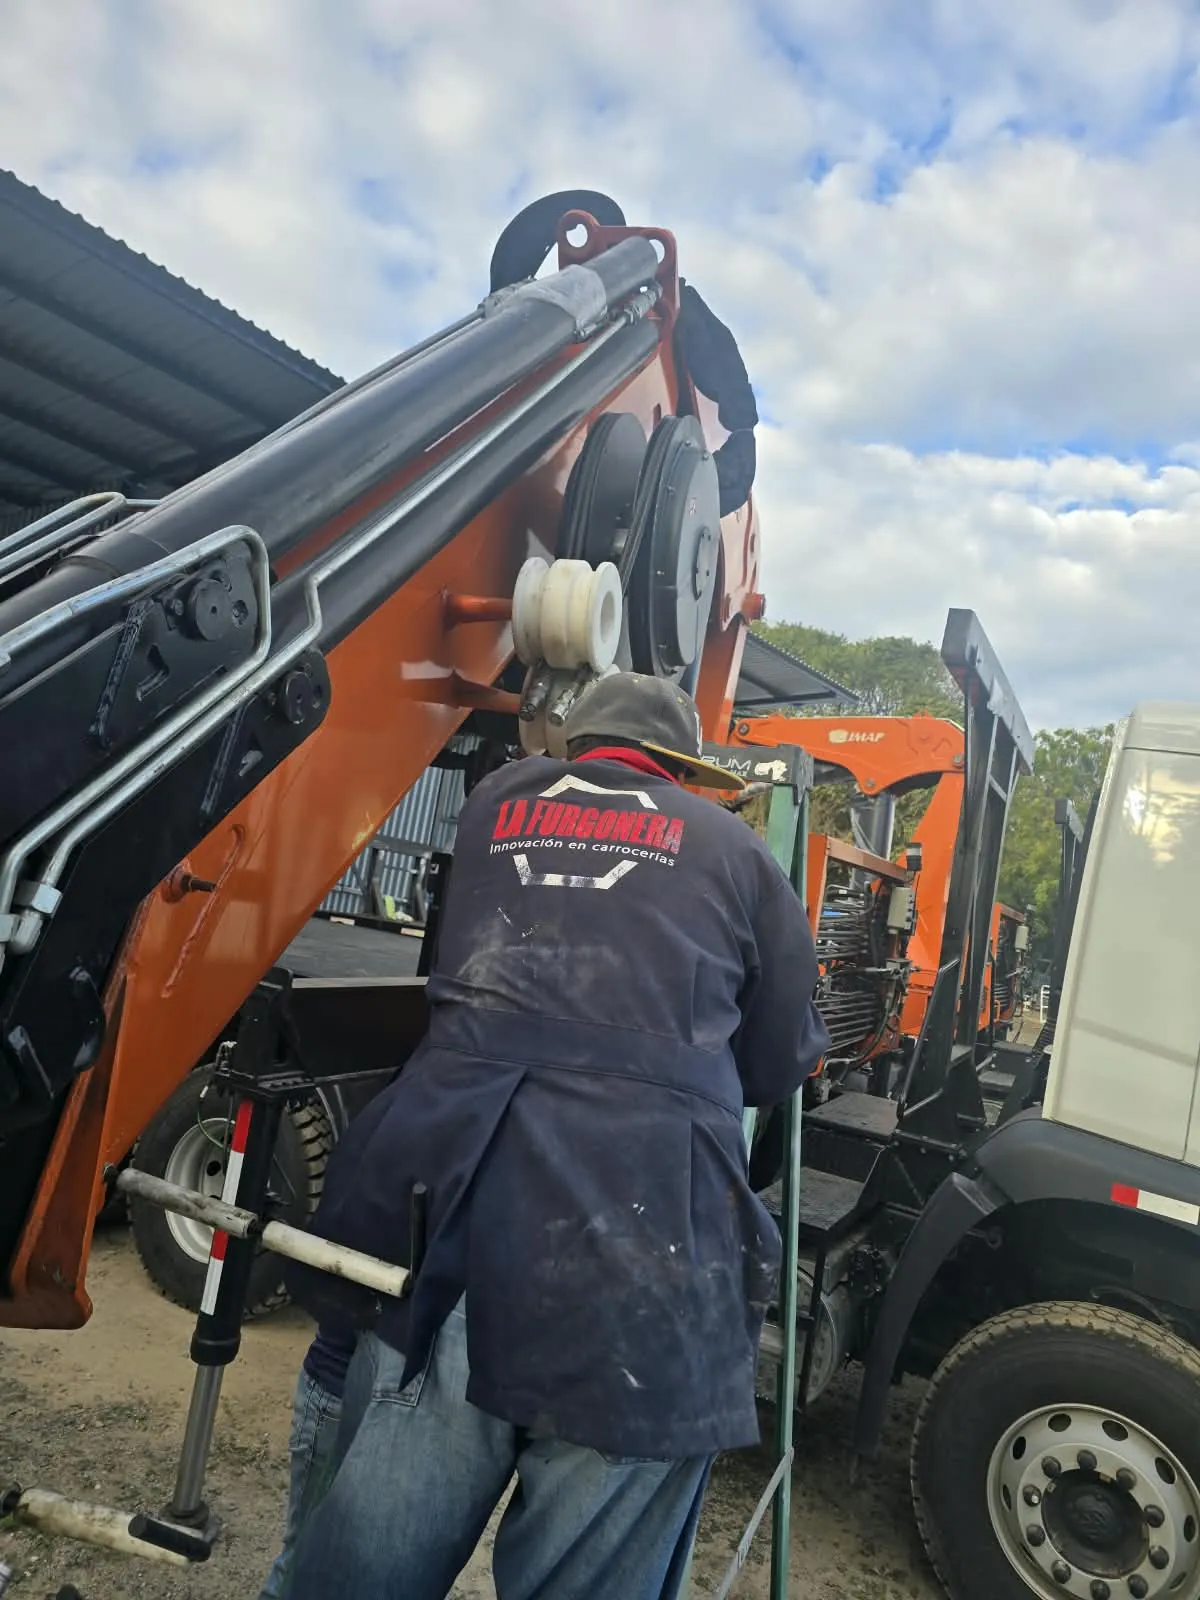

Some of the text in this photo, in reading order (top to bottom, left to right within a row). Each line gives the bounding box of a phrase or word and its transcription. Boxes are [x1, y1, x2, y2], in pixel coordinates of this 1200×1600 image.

[492, 799, 685, 854] LA FURGONERA
[489, 838, 676, 867] Innovación en carrocerías
